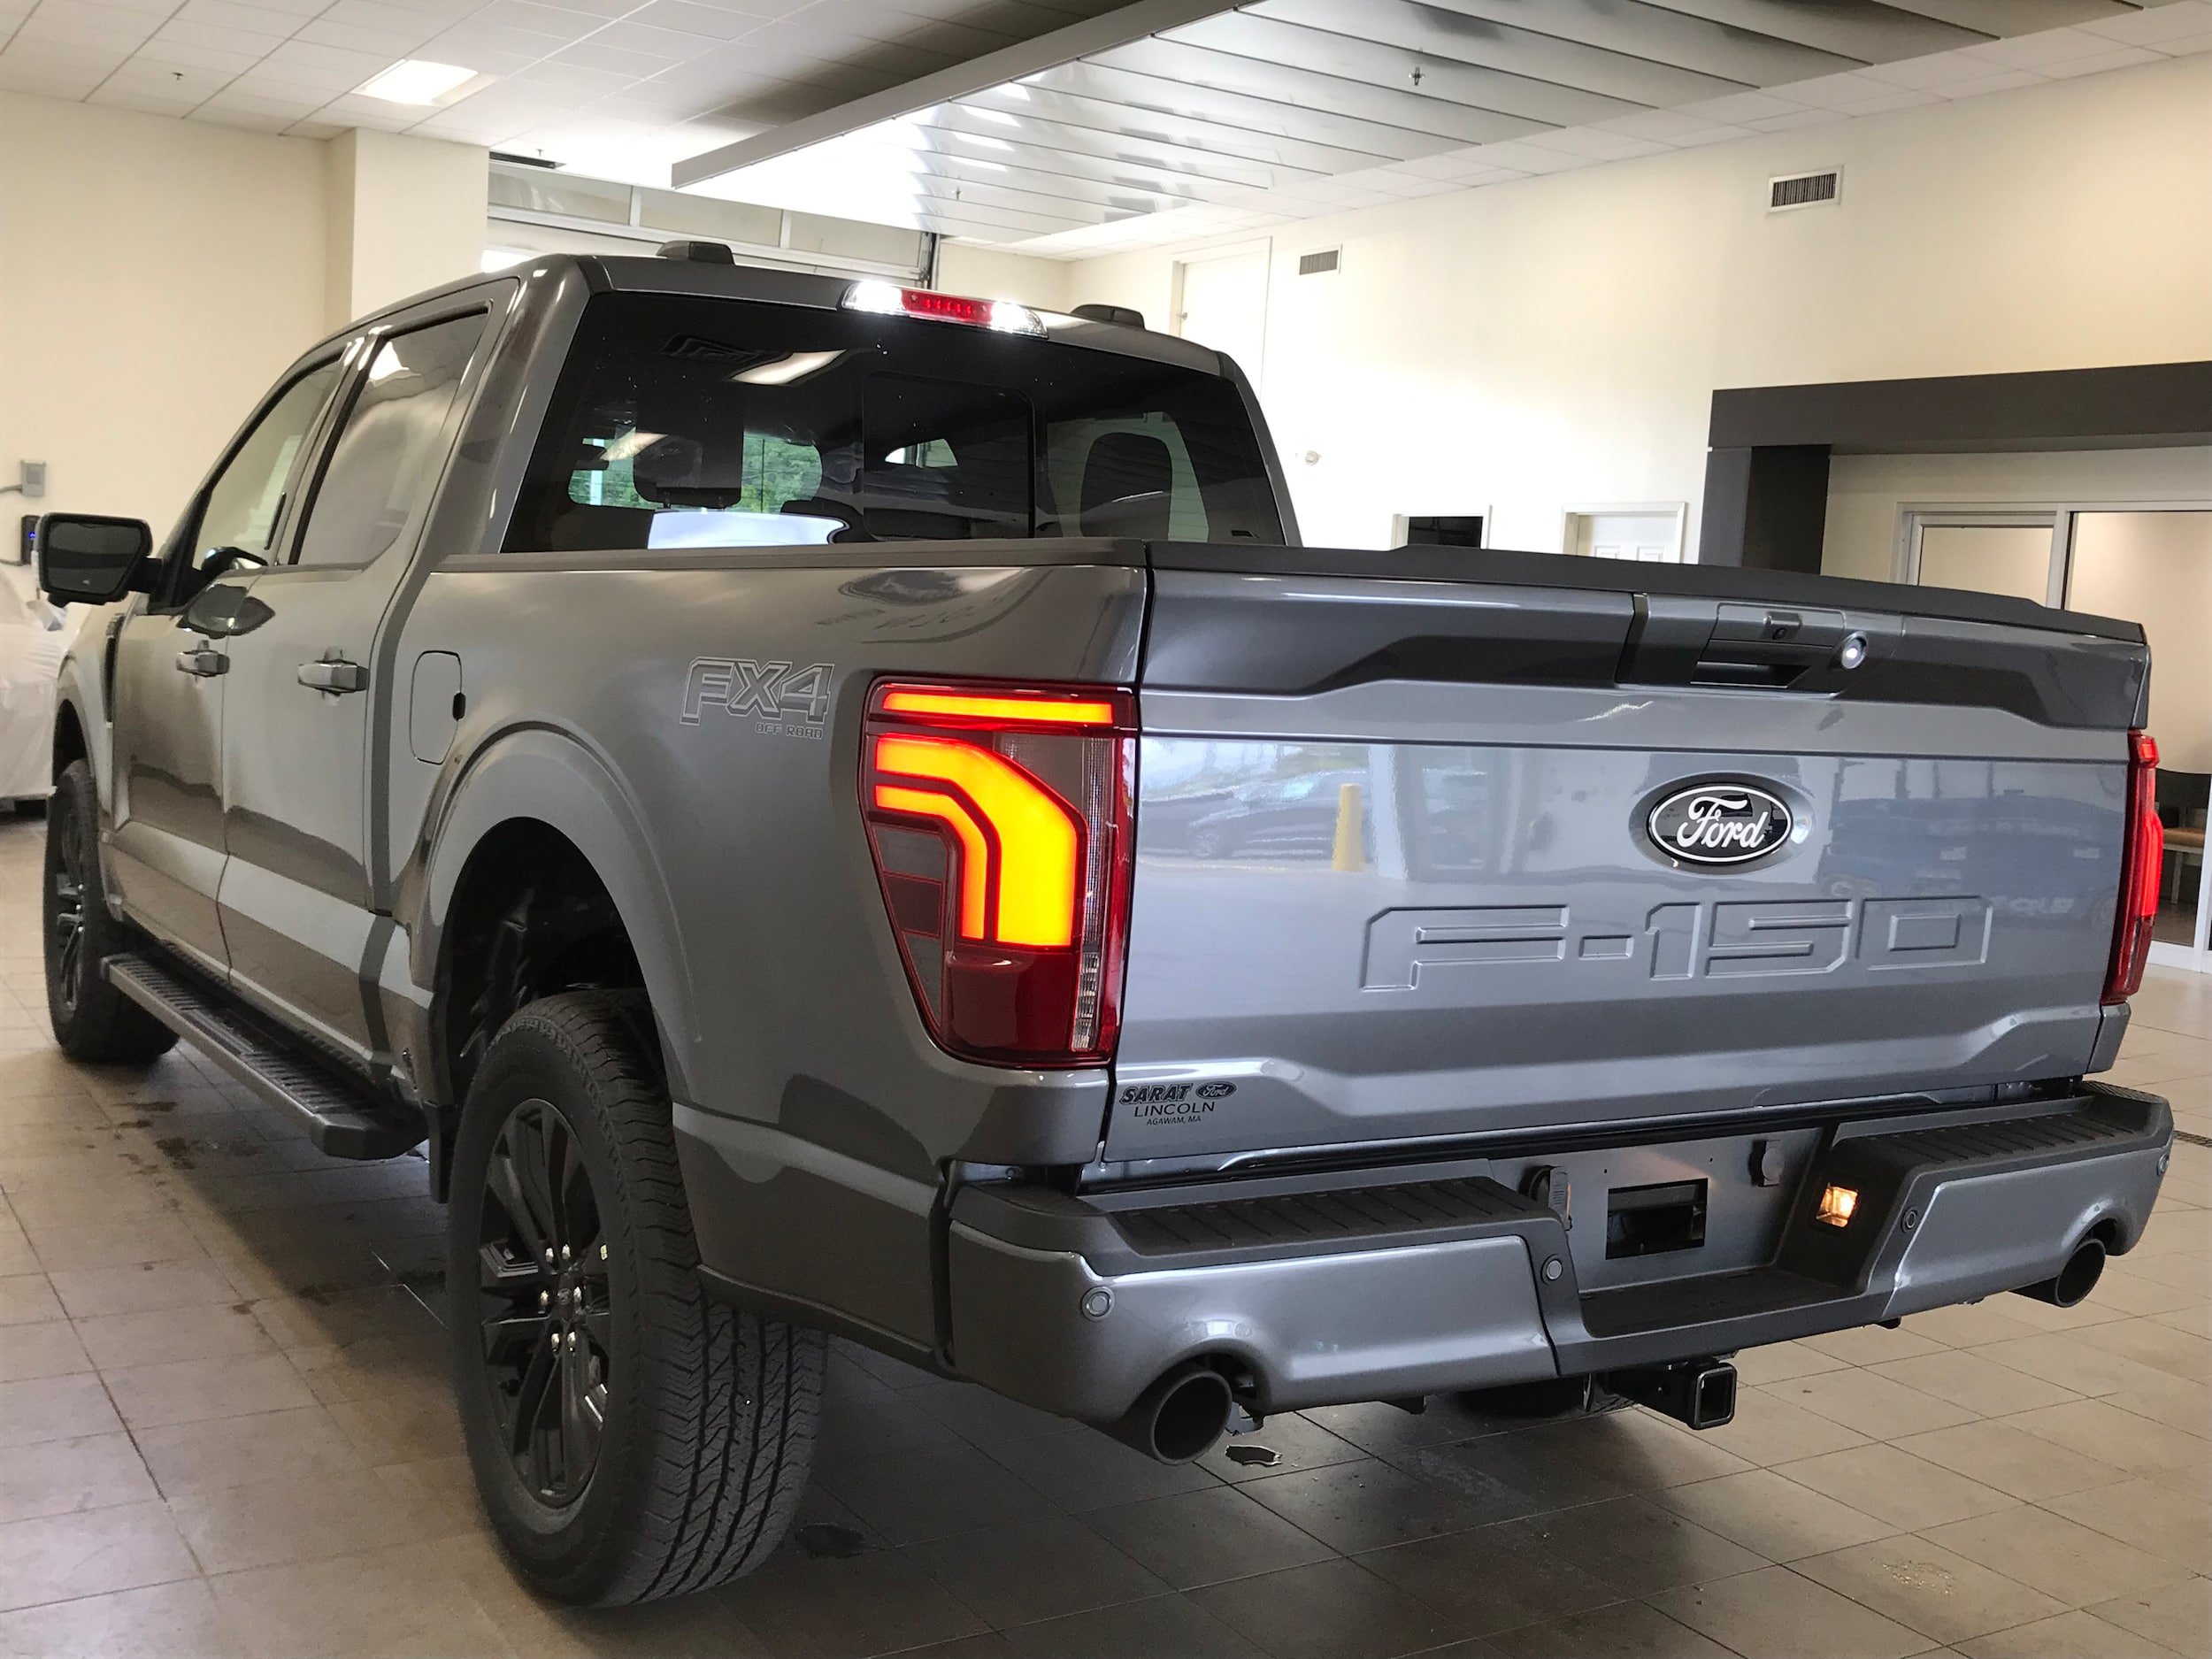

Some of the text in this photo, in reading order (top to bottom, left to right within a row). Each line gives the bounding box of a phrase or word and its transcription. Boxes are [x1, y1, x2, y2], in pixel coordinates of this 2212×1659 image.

[680, 656, 835, 726] FX4
[756, 722, 824, 740] OFF ROAD
[1676, 796, 1769, 849] Ford
[1360, 895, 1994, 992] F-150
[1119, 1082, 1194, 1105] SARAT
[1133, 1102, 1216, 1118] LINCOLN
[1146, 1117, 1187, 1126] AGAWAM,
